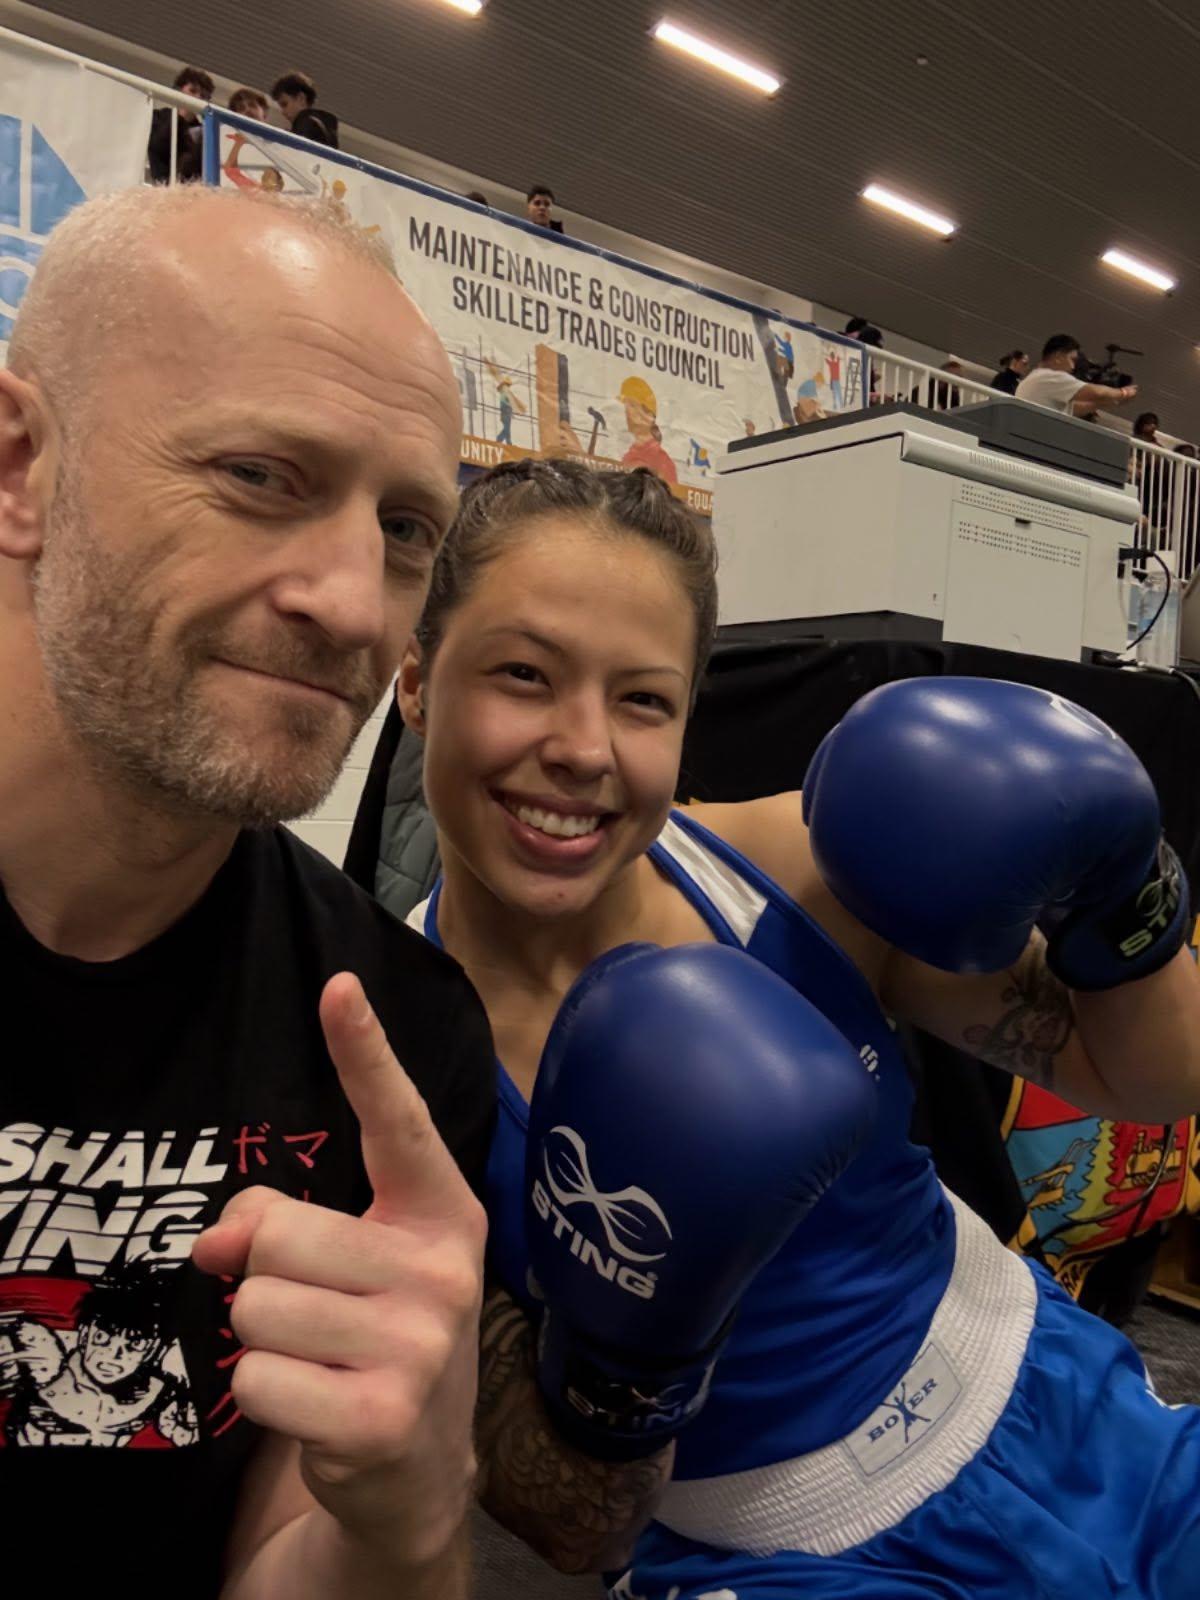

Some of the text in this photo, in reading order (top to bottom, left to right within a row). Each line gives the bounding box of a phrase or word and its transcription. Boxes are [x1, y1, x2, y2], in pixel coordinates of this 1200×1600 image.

[408, 216, 755, 362] MAINTENANCE & CONSTRUCTION
[452, 275, 725, 390] SKILLED TRADES COUNCIL
[531, 1179, 658, 1300] STING
[565, 1384, 692, 1432] STIN
[867, 1377, 938, 1444] BOXER
